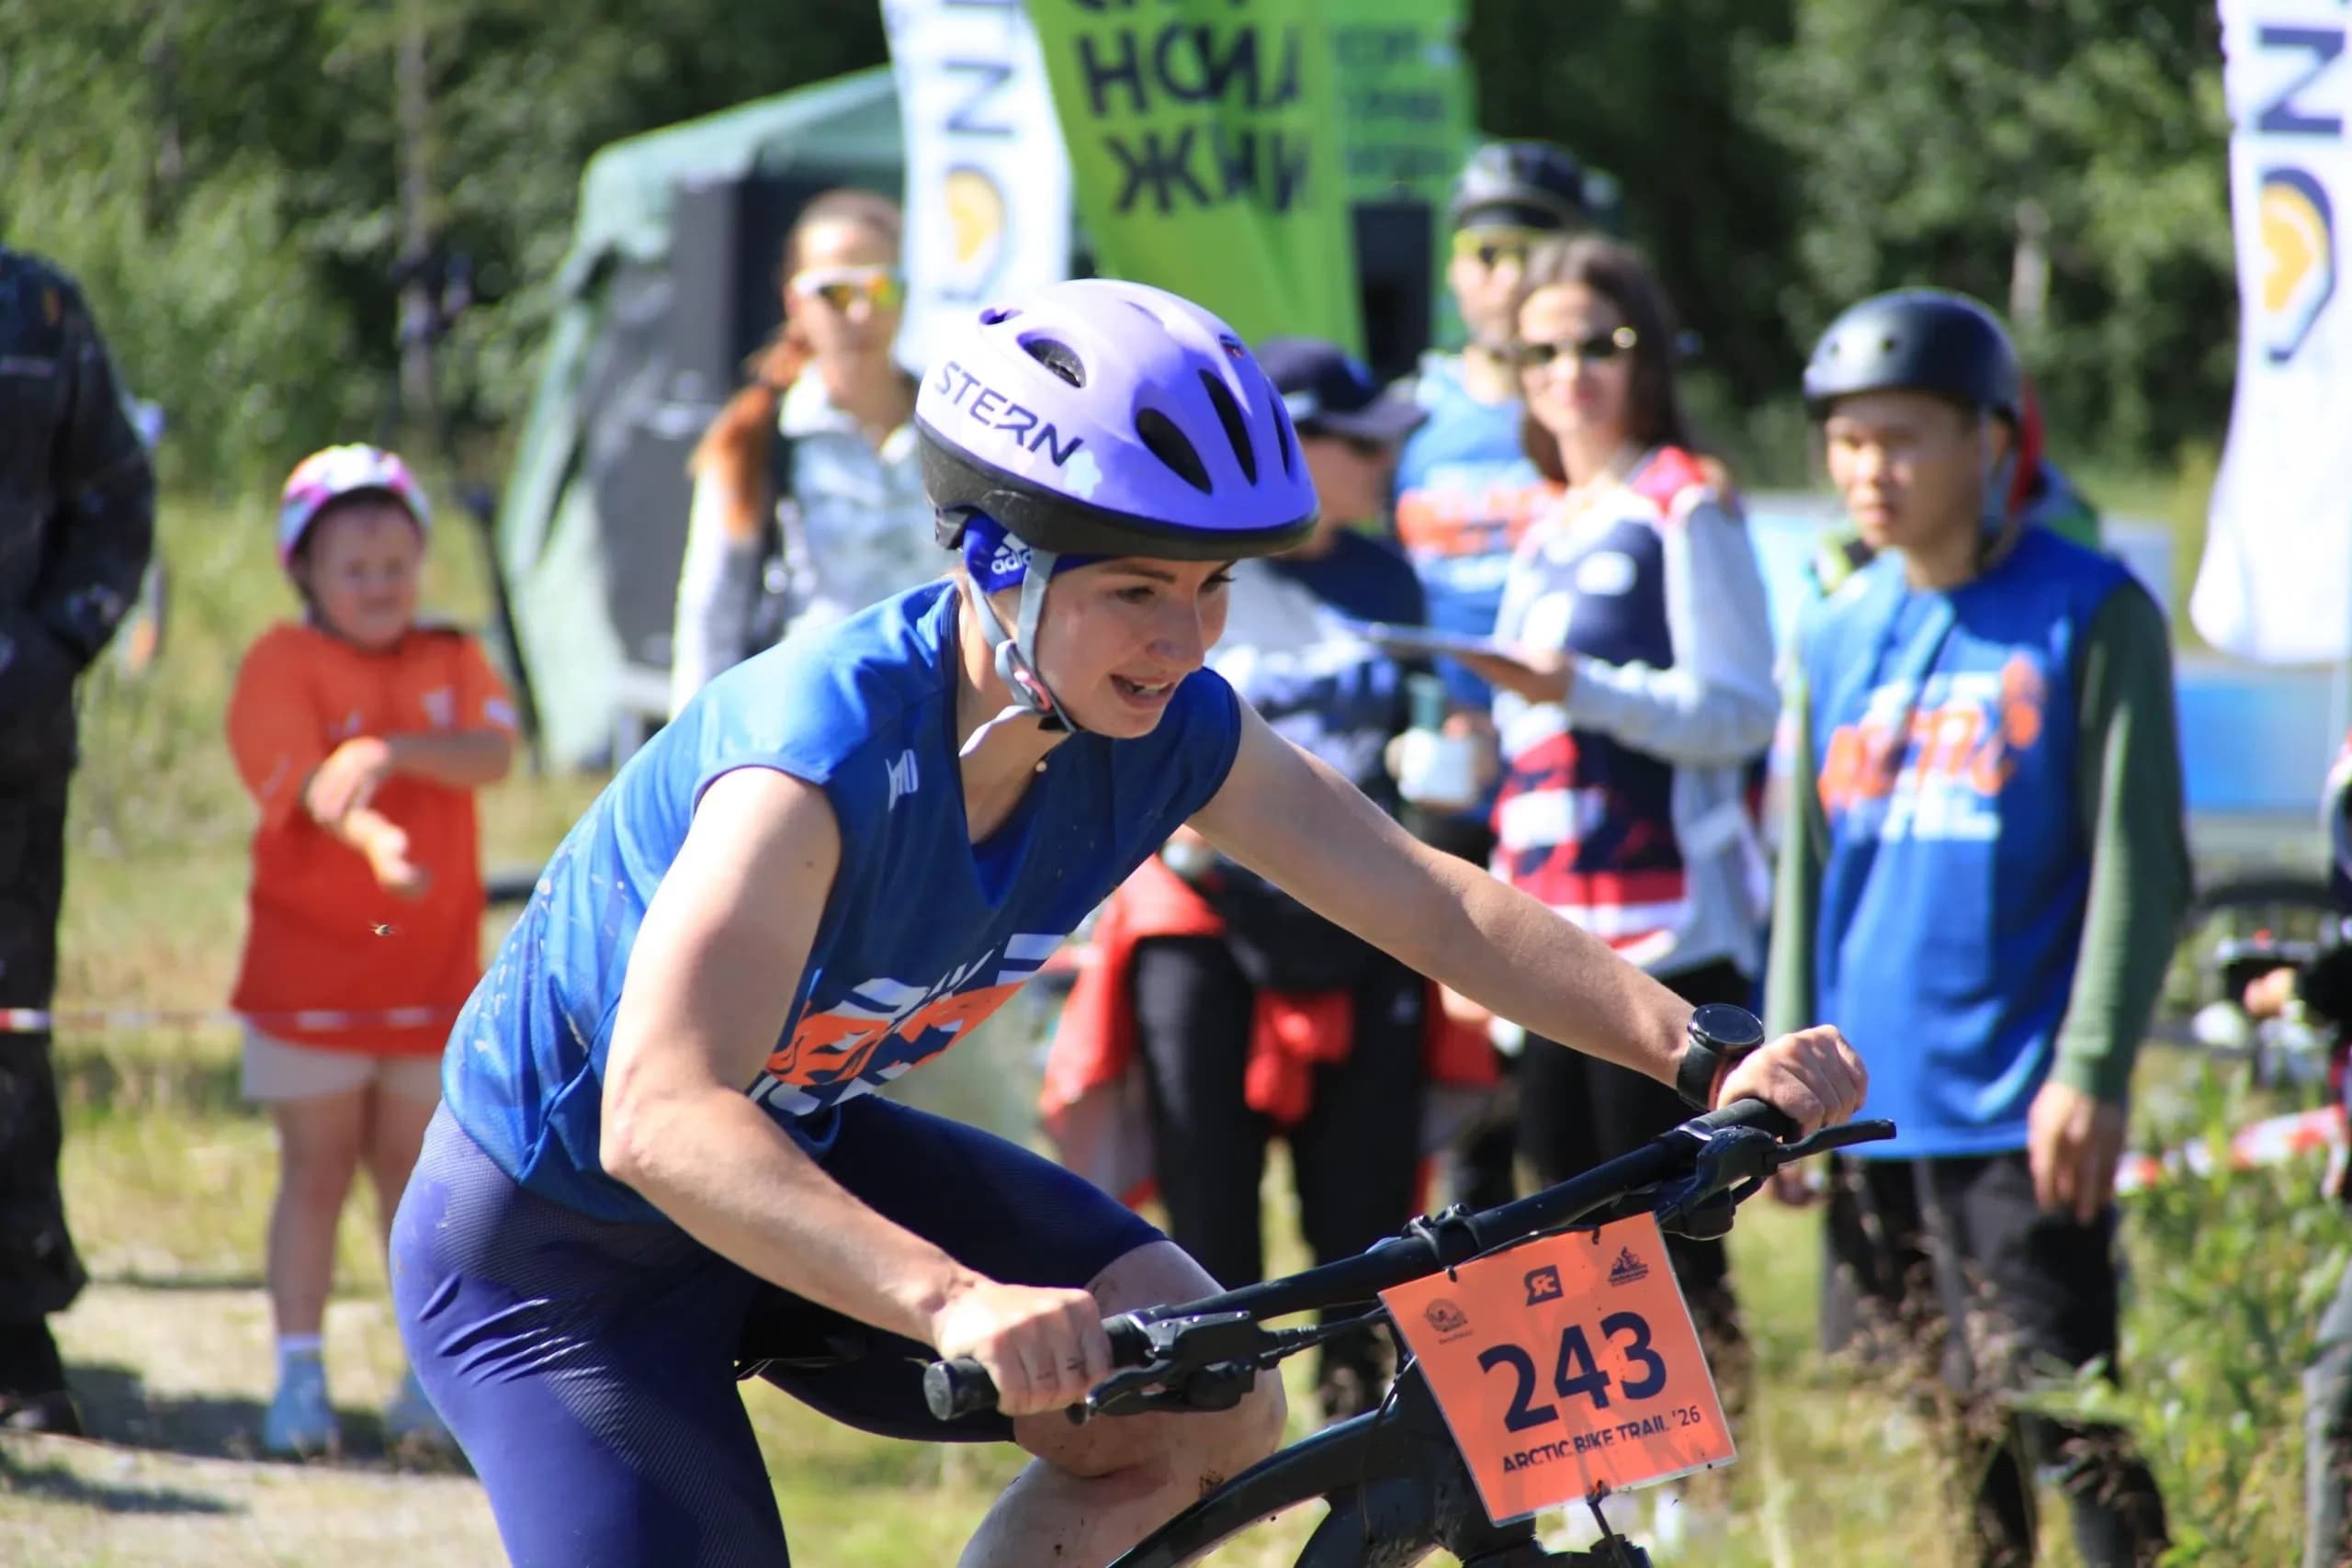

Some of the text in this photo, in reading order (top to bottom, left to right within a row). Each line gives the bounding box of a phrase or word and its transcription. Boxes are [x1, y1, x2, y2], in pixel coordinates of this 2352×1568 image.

[935, 361, 1083, 468] STERN
[1477, 1312, 1667, 1433] 243
[1503, 1404, 1701, 1473] ARCTIC BIKE TRAIL '26
